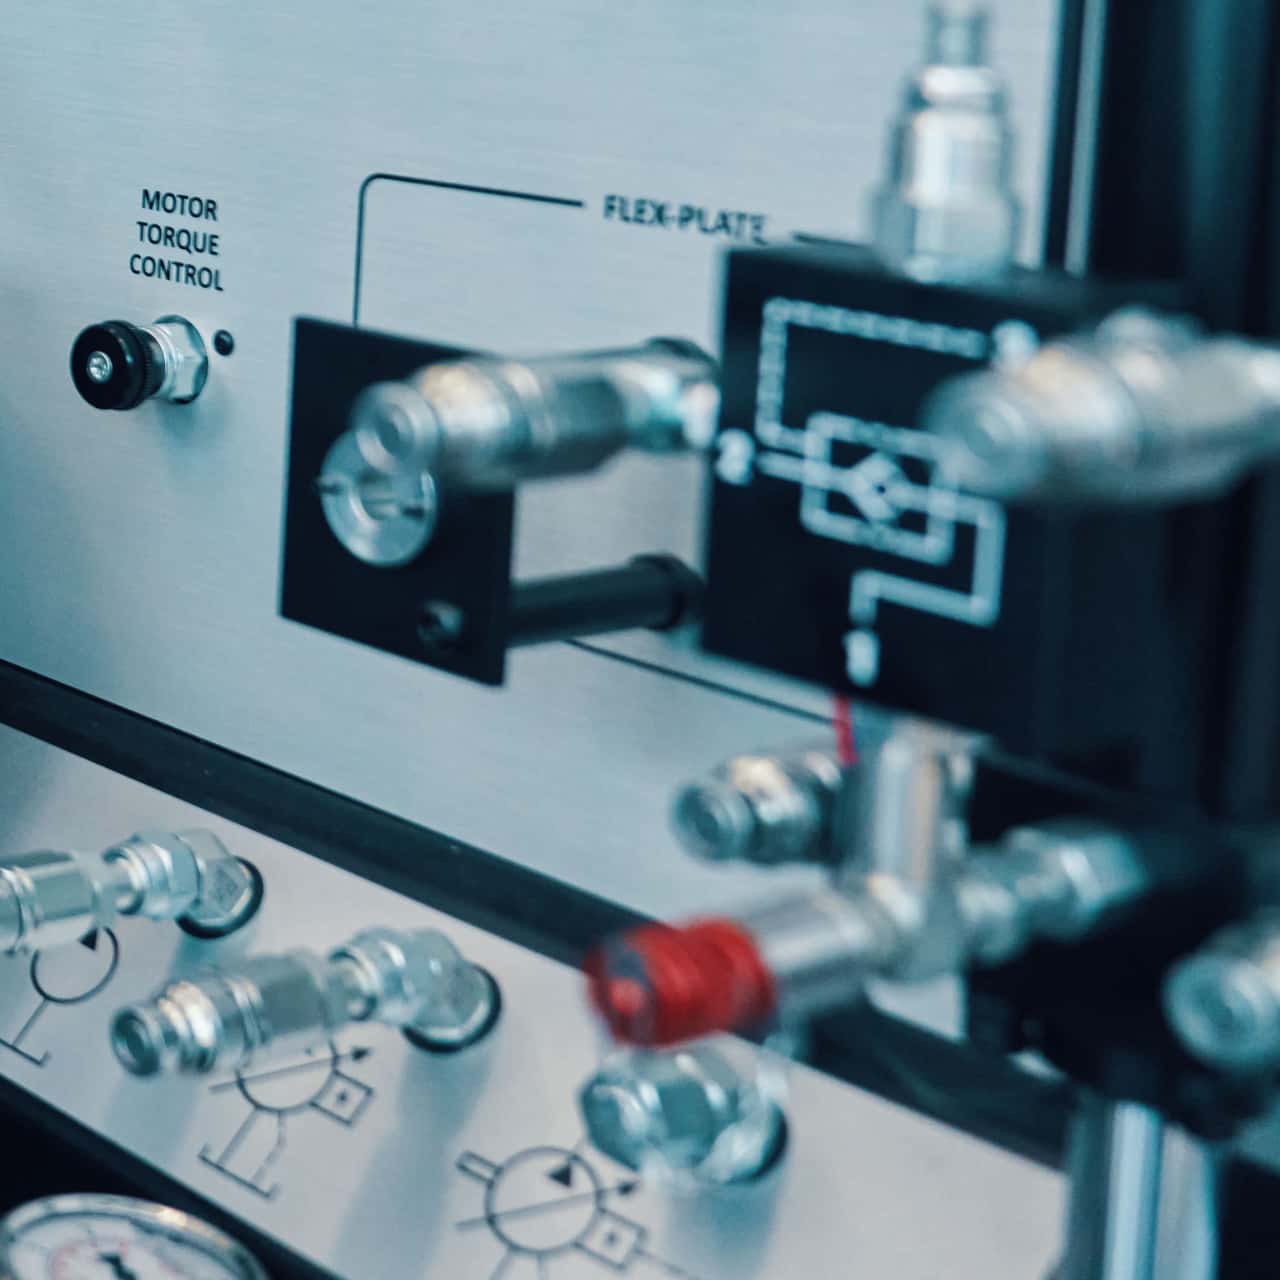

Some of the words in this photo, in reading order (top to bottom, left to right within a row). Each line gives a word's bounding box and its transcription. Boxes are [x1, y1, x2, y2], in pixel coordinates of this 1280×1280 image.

[141, 188, 217, 221] MOTOR
[603, 194, 769, 246] FLEX-PLATE
[136, 220, 220, 256] TORQUE
[129, 253, 224, 292] CONTROL
